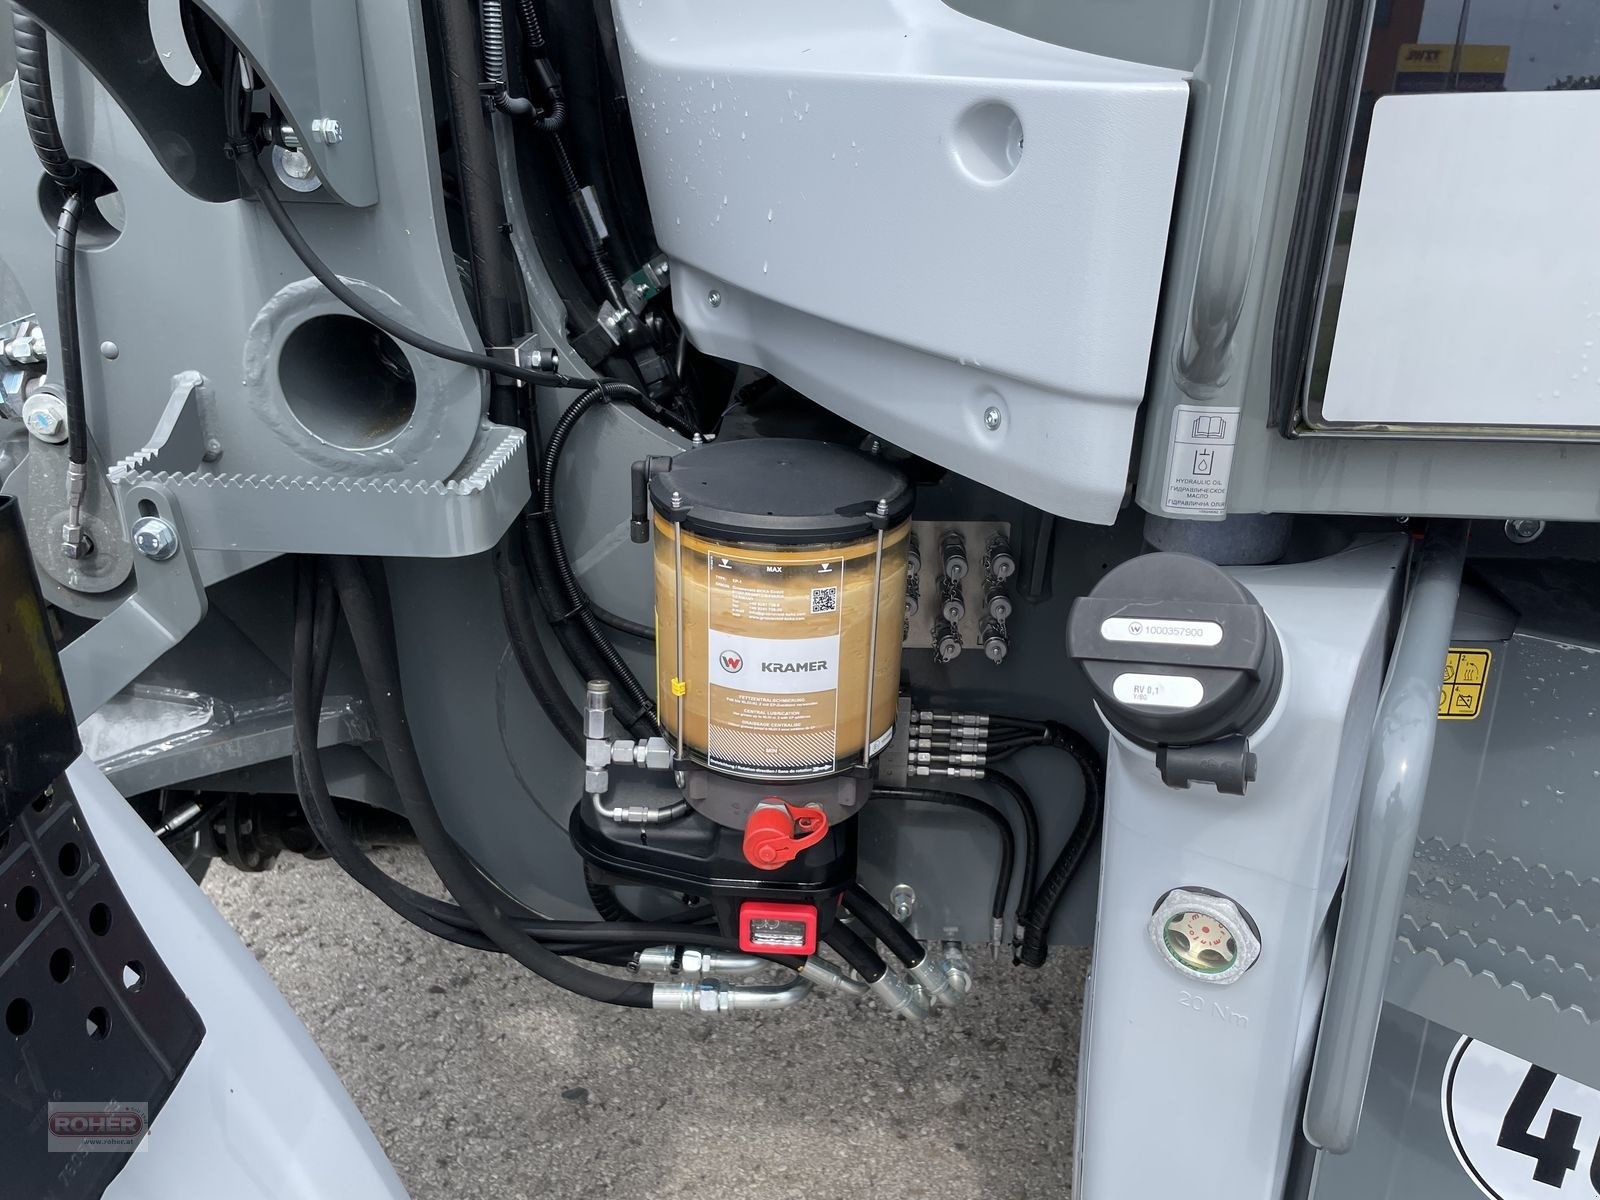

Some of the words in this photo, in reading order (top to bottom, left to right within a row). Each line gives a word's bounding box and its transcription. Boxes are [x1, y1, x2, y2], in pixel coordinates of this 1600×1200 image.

[1145, 626, 1203, 637] 1000357900
[761, 660, 828, 673] KRAMER
[1133, 685, 1145, 693] RV
[1146, 687, 1159, 695] 0,1
[1178, 990, 1205, 1010] 20
[1210, 1001, 1249, 1029] Nm
[1497, 1064, 1600, 1196] 4
